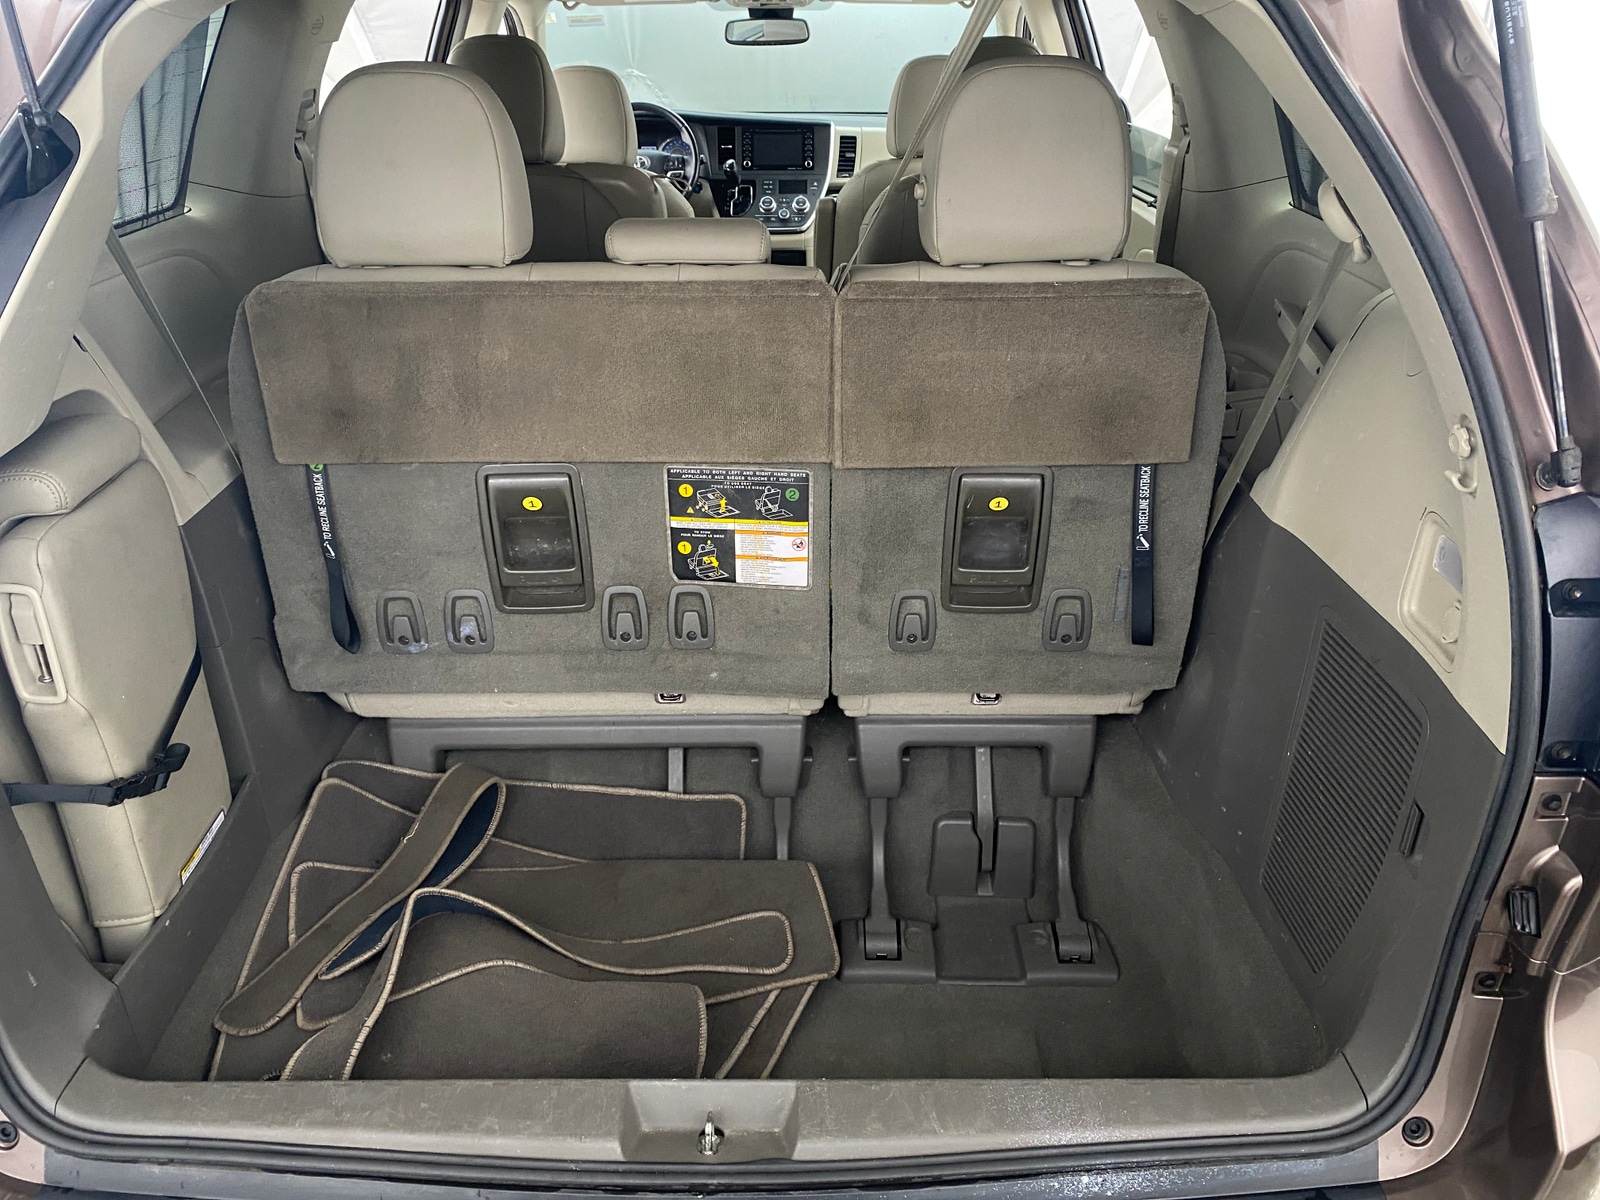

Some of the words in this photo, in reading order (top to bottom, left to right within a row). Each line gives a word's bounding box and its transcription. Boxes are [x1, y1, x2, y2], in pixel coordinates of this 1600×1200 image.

[1504, 1, 1515, 45] STABILUS
[313, 473, 325, 505] SEATBACK
[1140, 466, 1151, 498] SEATBACK
[788, 489, 796, 500] 2
[528, 500, 536, 508] 1
[995, 500, 1002, 508] 1
[1139, 500, 1150, 523] RECLINE
[319, 505, 331, 531] RECLINE
[323, 530, 332, 540] TO
[1139, 523, 1149, 532] TO
